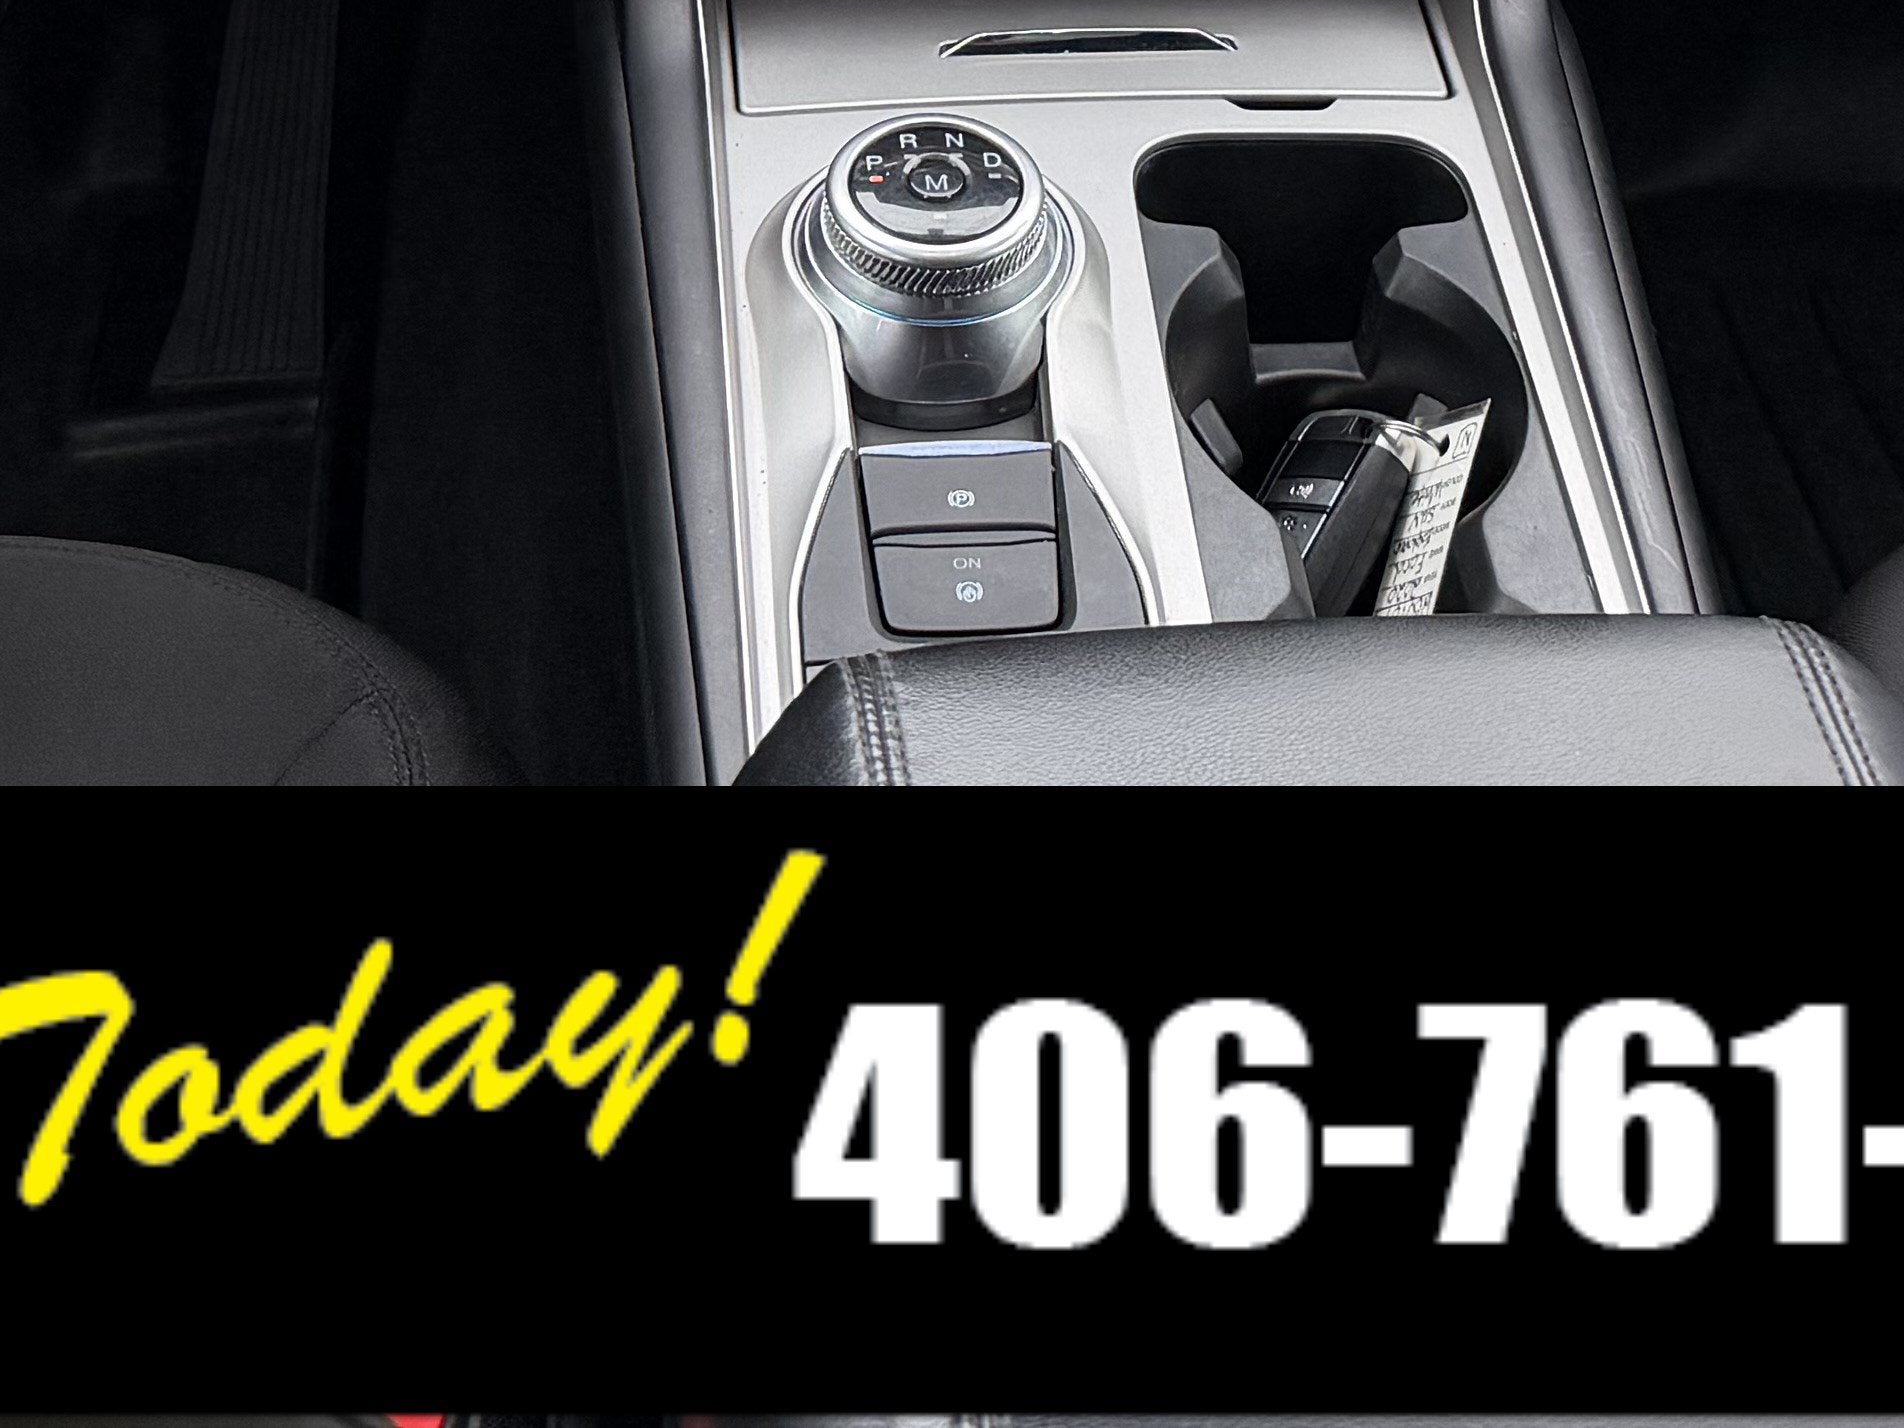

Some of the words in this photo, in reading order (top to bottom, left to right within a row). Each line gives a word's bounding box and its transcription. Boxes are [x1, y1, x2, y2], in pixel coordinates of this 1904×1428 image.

[900, 133, 918, 149] R
[945, 133, 965, 149] N
[865, 155, 883, 171] P
[983, 151, 1002, 169] D
[924, 174, 949, 191] M
[953, 557, 982, 570] ON
